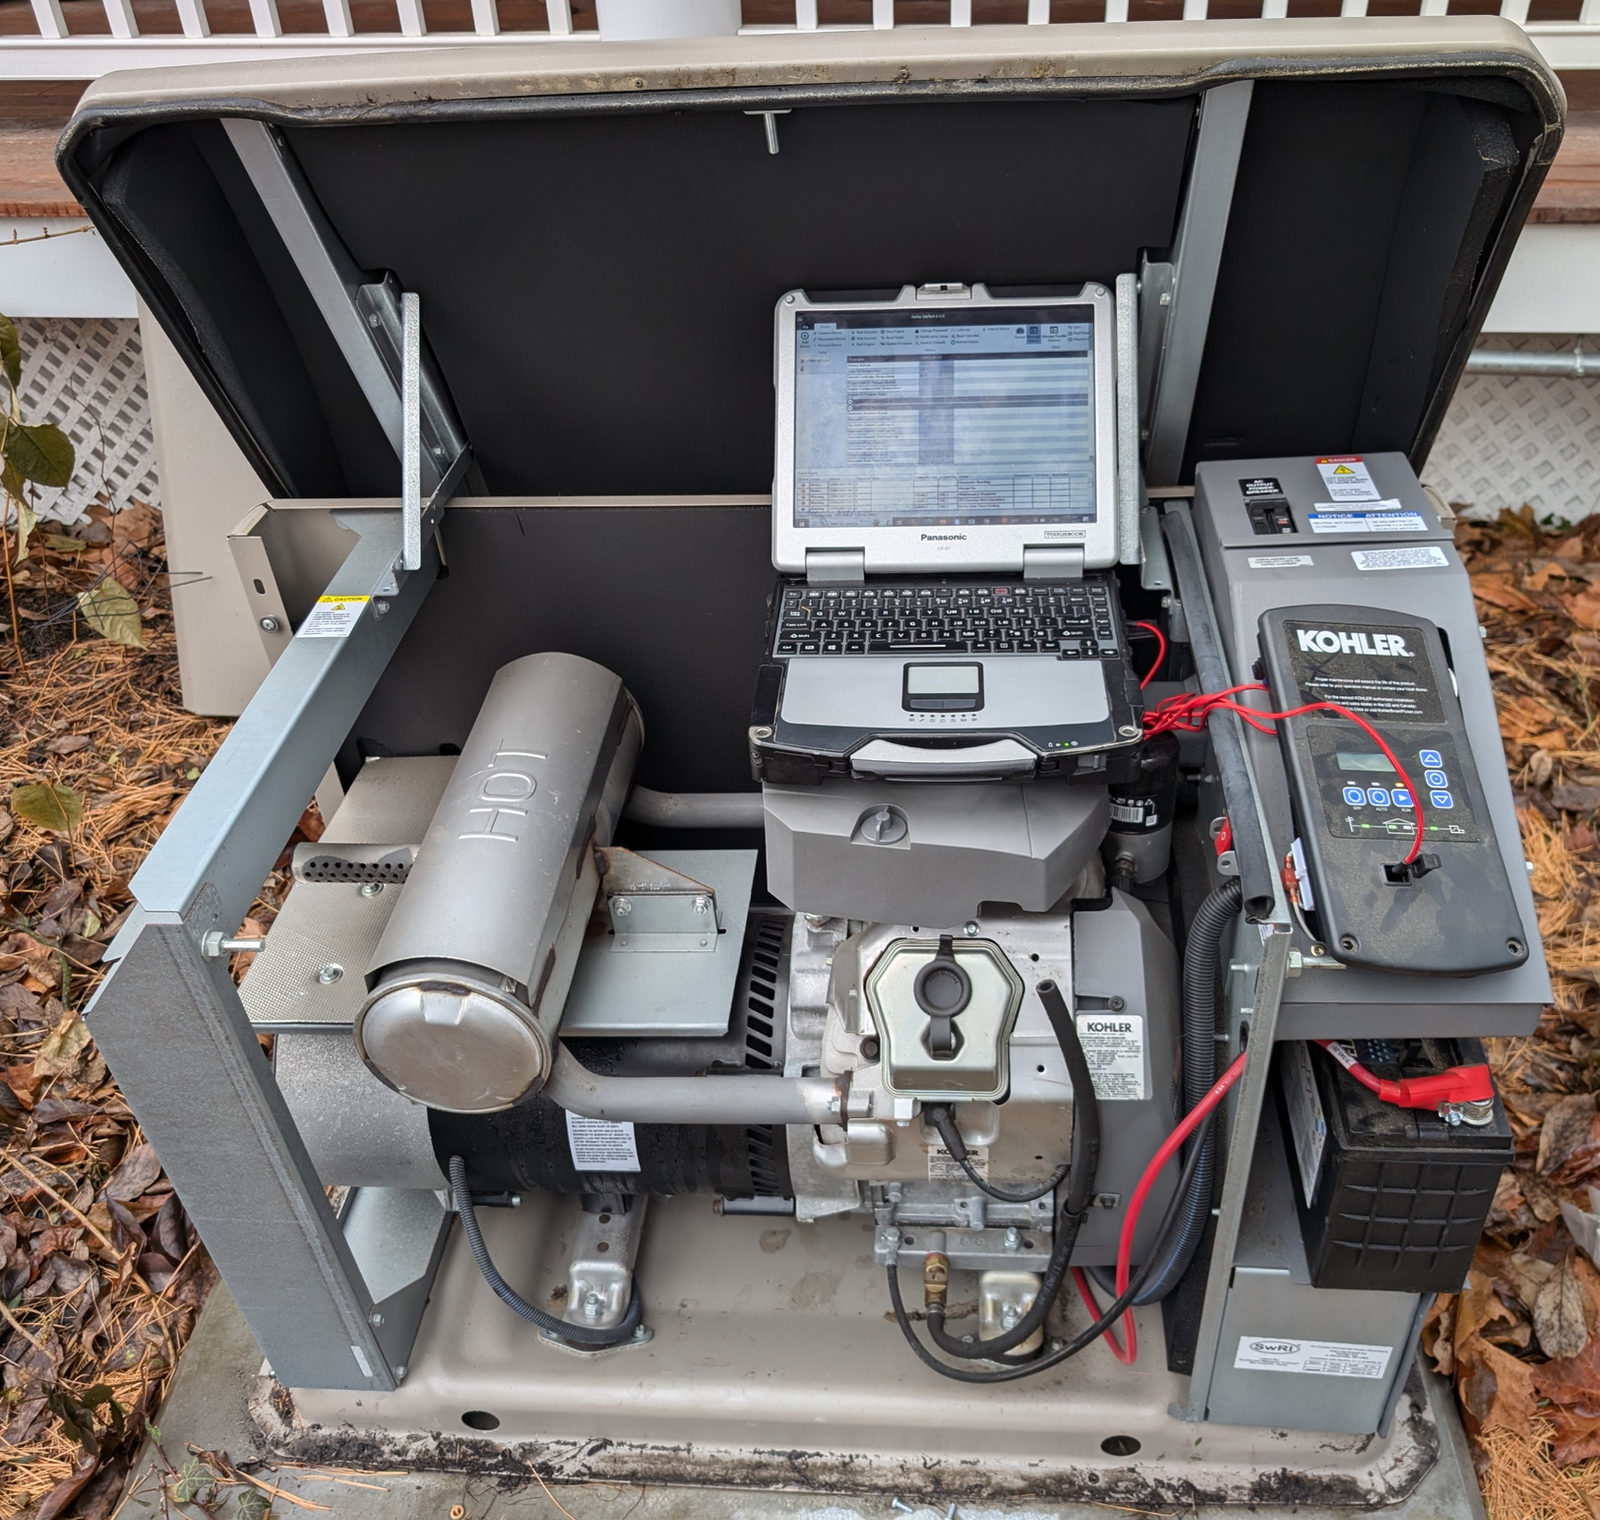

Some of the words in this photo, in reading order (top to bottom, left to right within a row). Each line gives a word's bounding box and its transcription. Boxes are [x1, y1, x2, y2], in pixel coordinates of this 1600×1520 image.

[1296, 630, 1409, 658] KOHLER
[458, 739, 549, 843] HOT
[1087, 1022, 1132, 1032] KOHLER
[1254, 1344, 1294, 1352] SwRI
